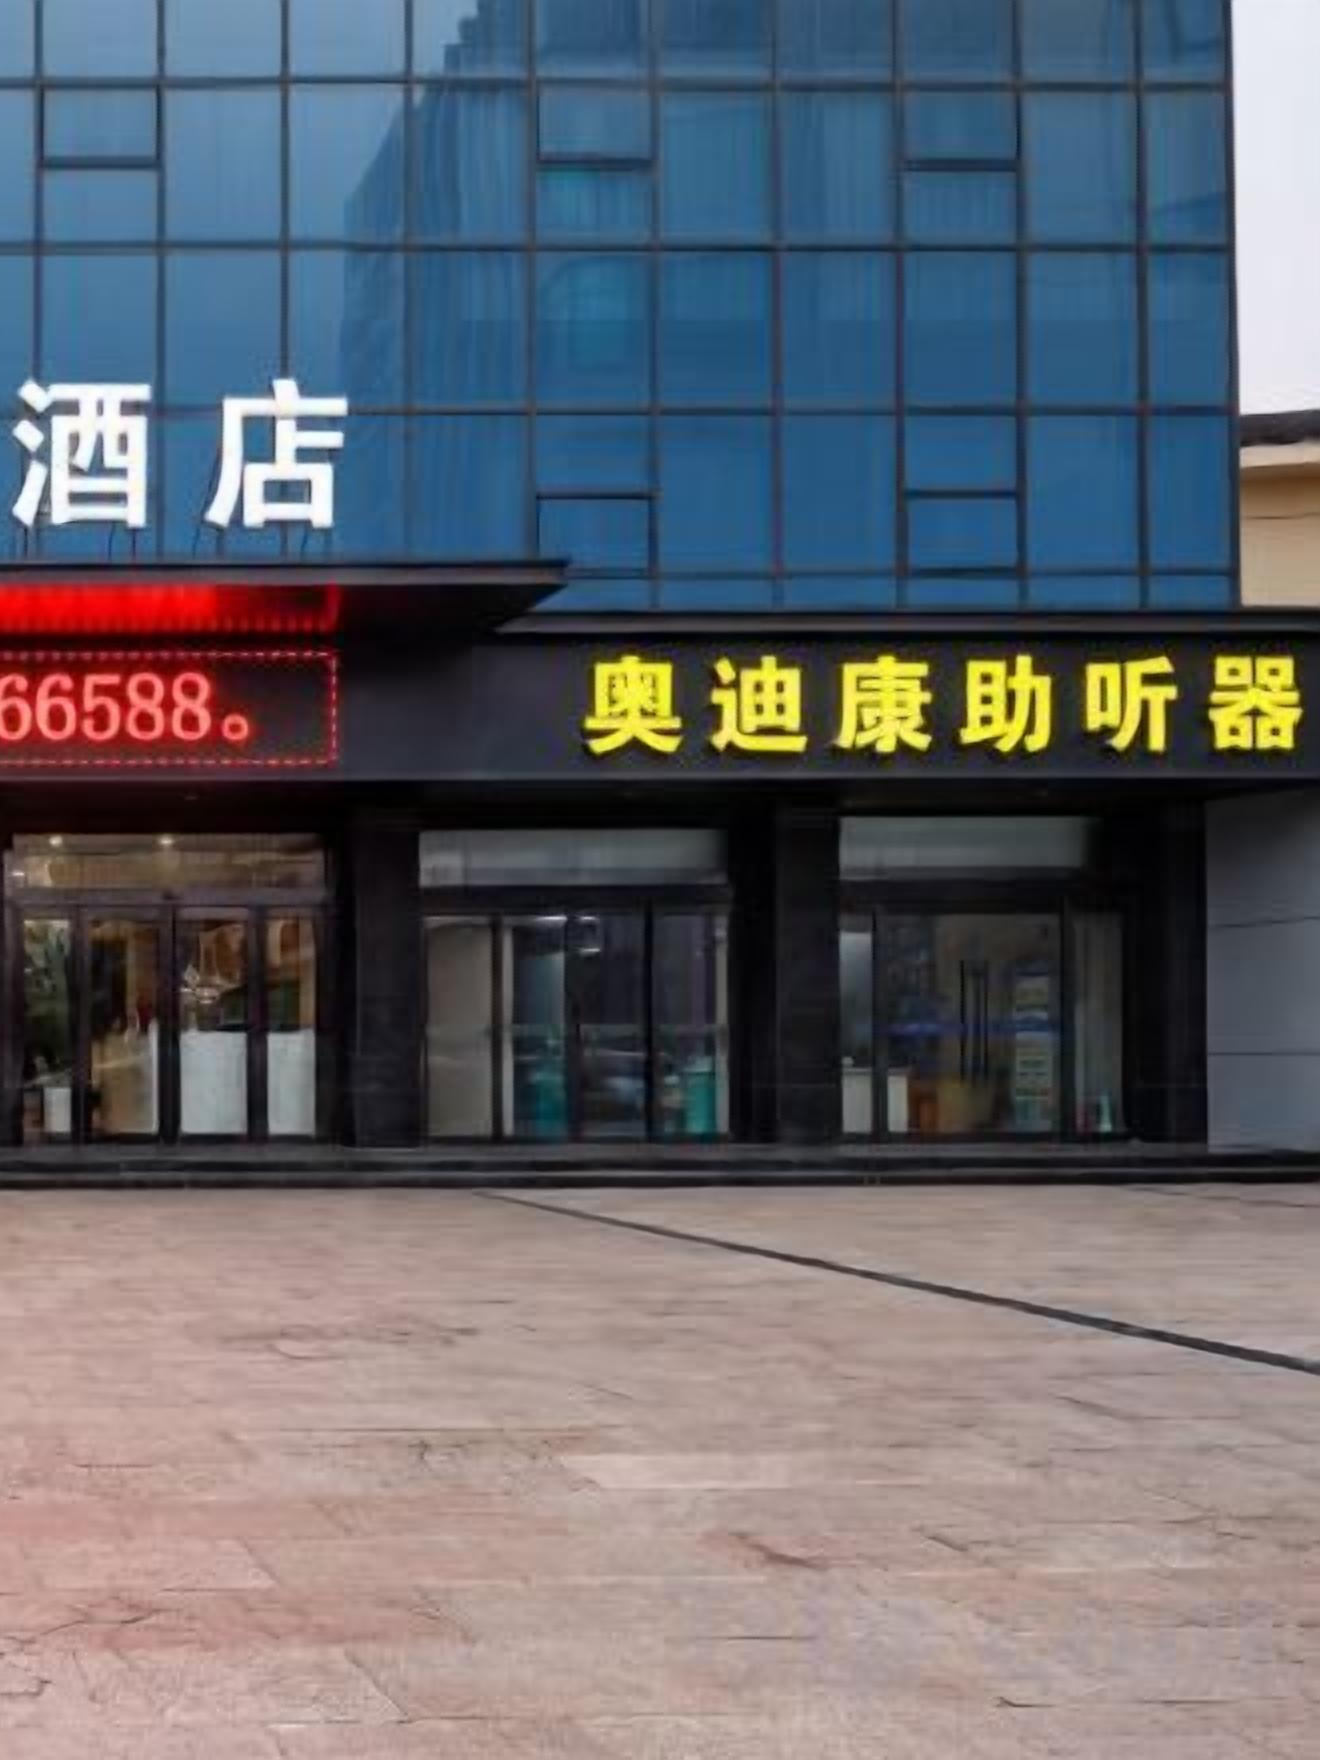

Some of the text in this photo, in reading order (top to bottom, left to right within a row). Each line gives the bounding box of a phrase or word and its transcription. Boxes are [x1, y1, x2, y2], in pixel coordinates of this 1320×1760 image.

[584, 655, 1303, 752] 奥迪康助听器
